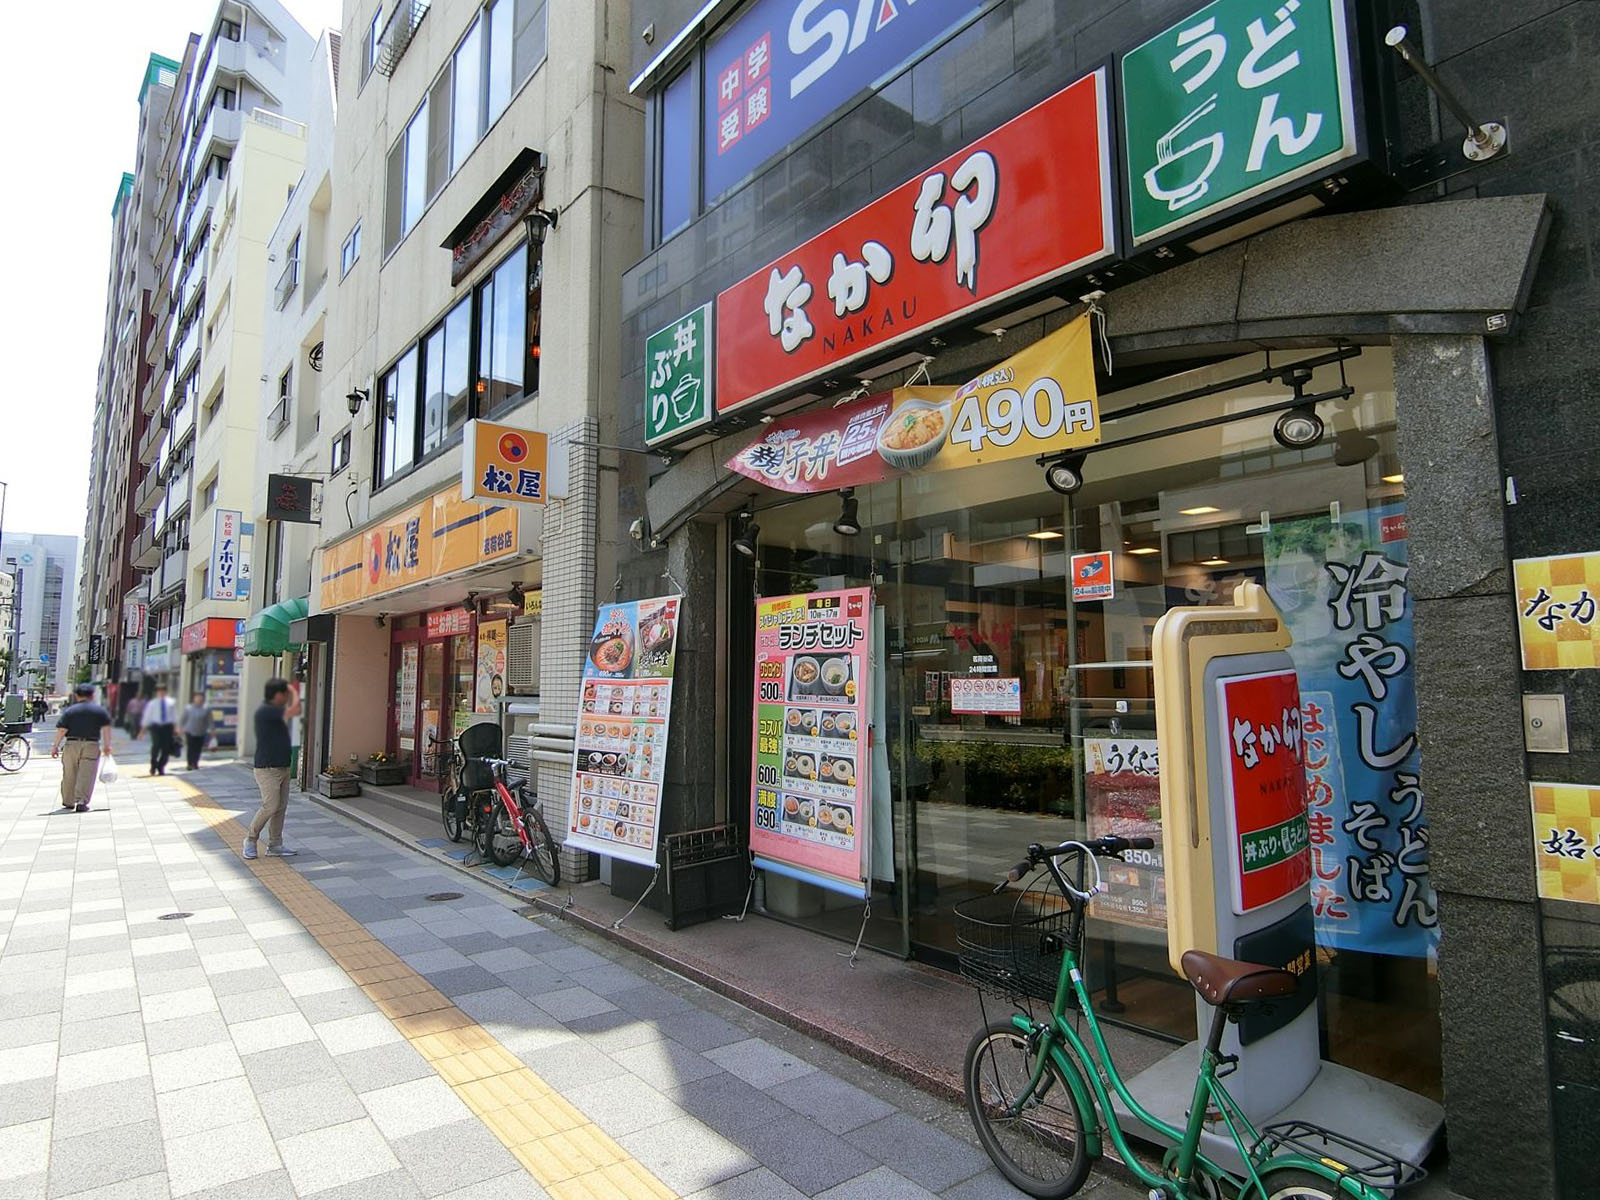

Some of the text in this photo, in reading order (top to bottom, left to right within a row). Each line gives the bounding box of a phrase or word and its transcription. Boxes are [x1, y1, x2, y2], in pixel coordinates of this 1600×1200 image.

[1169, 0, 1323, 172] うどん
[763, 150, 998, 354] なか卯
[822, 296, 918, 355] NAKAU
[650, 318, 697, 433] 丼ぶり
[950, 376, 1095, 452] 490円
[482, 464, 542, 499] 松屋
[384, 516, 421, 576] 松屋
[779, 620, 864, 650] ランチセット
[1232, 706, 1302, 768] なか卯
[1298, 701, 1350, 918] はじめました
[1343, 802, 1397, 902] そば
